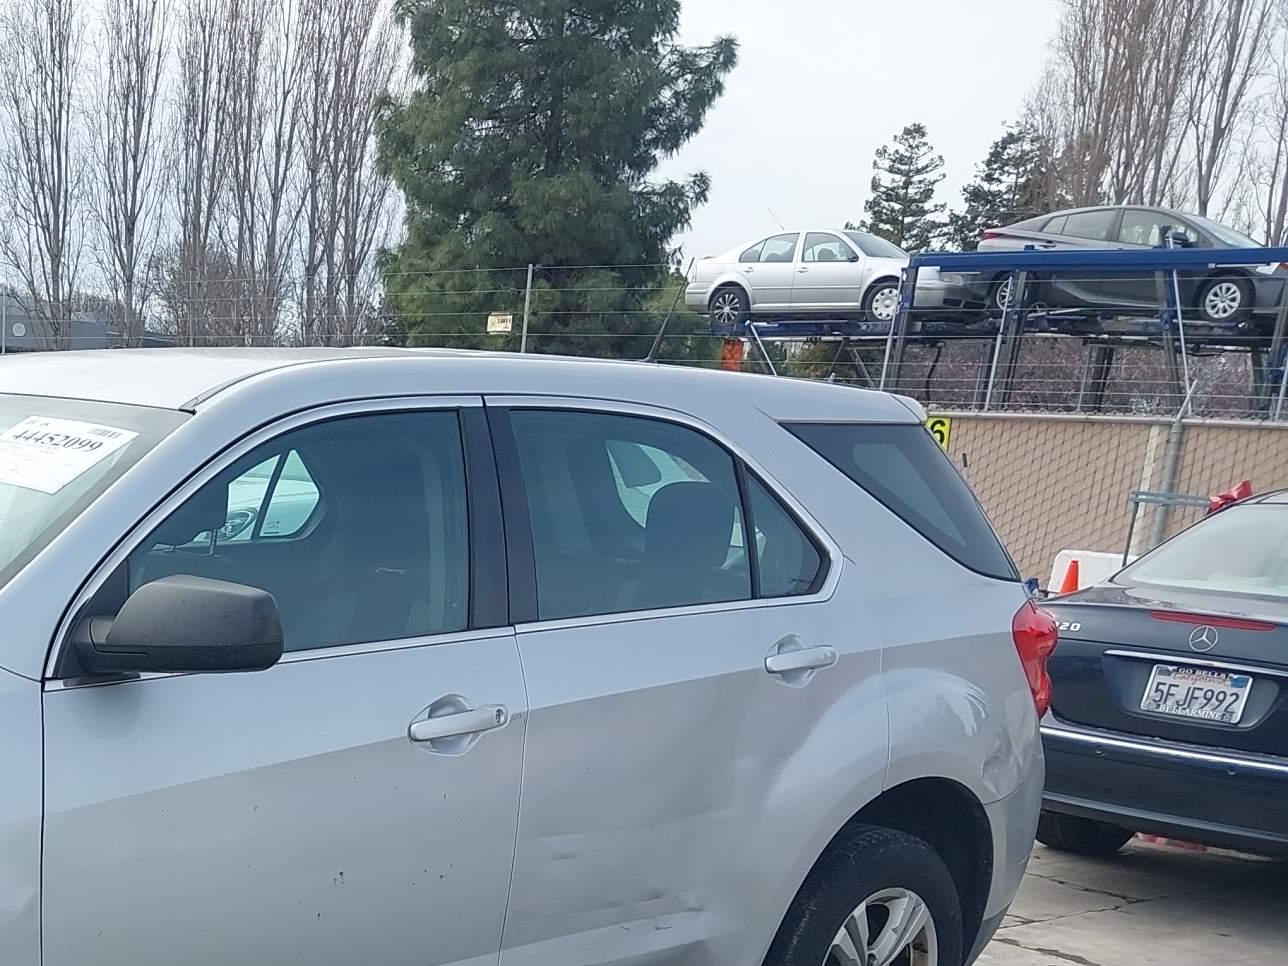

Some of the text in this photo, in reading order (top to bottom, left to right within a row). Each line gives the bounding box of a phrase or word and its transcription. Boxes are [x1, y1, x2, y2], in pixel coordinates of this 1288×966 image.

[12, 429, 104, 452] 44452099
[930, 419, 946, 445] 6
[1195, 669, 1226, 680] BELLS
[1152, 681, 1240, 714] 5FJF992
[1159, 703, 1222, 720] BELLARMINE
